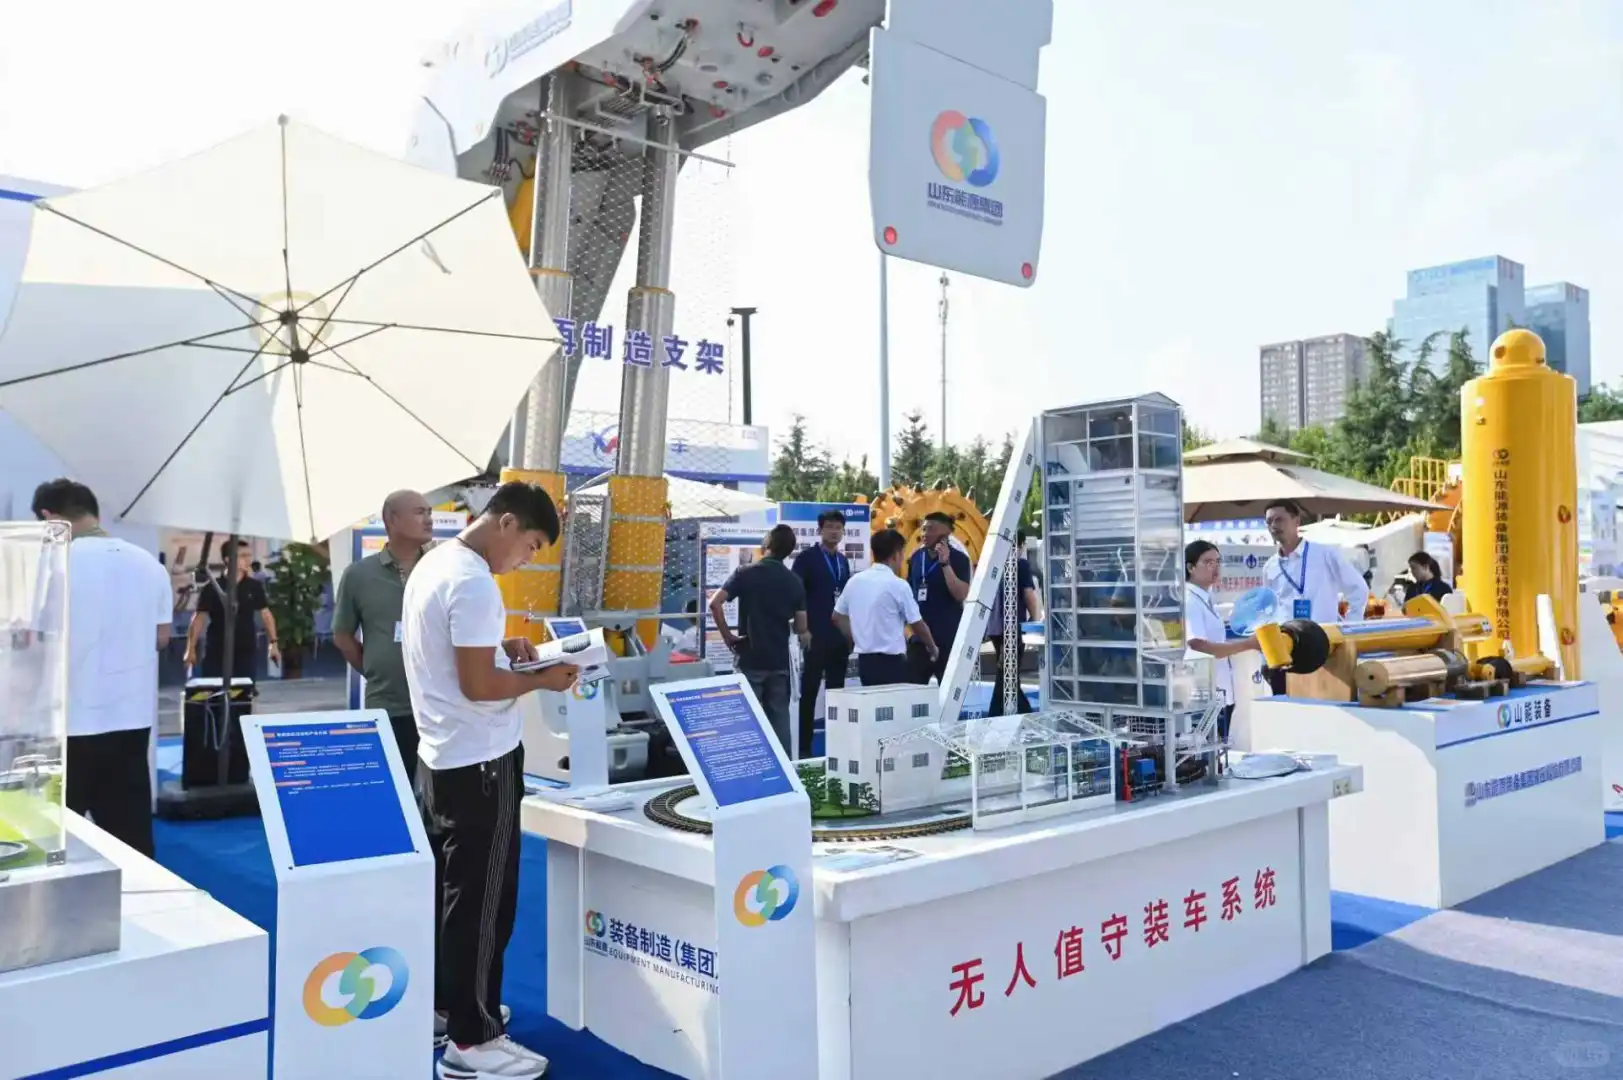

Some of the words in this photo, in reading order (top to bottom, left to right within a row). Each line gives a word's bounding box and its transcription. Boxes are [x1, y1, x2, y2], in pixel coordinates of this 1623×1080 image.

[609, 947, 651, 969] EQUIPMENT
[949, 866, 1277, 1017] 无人值守装车系统
